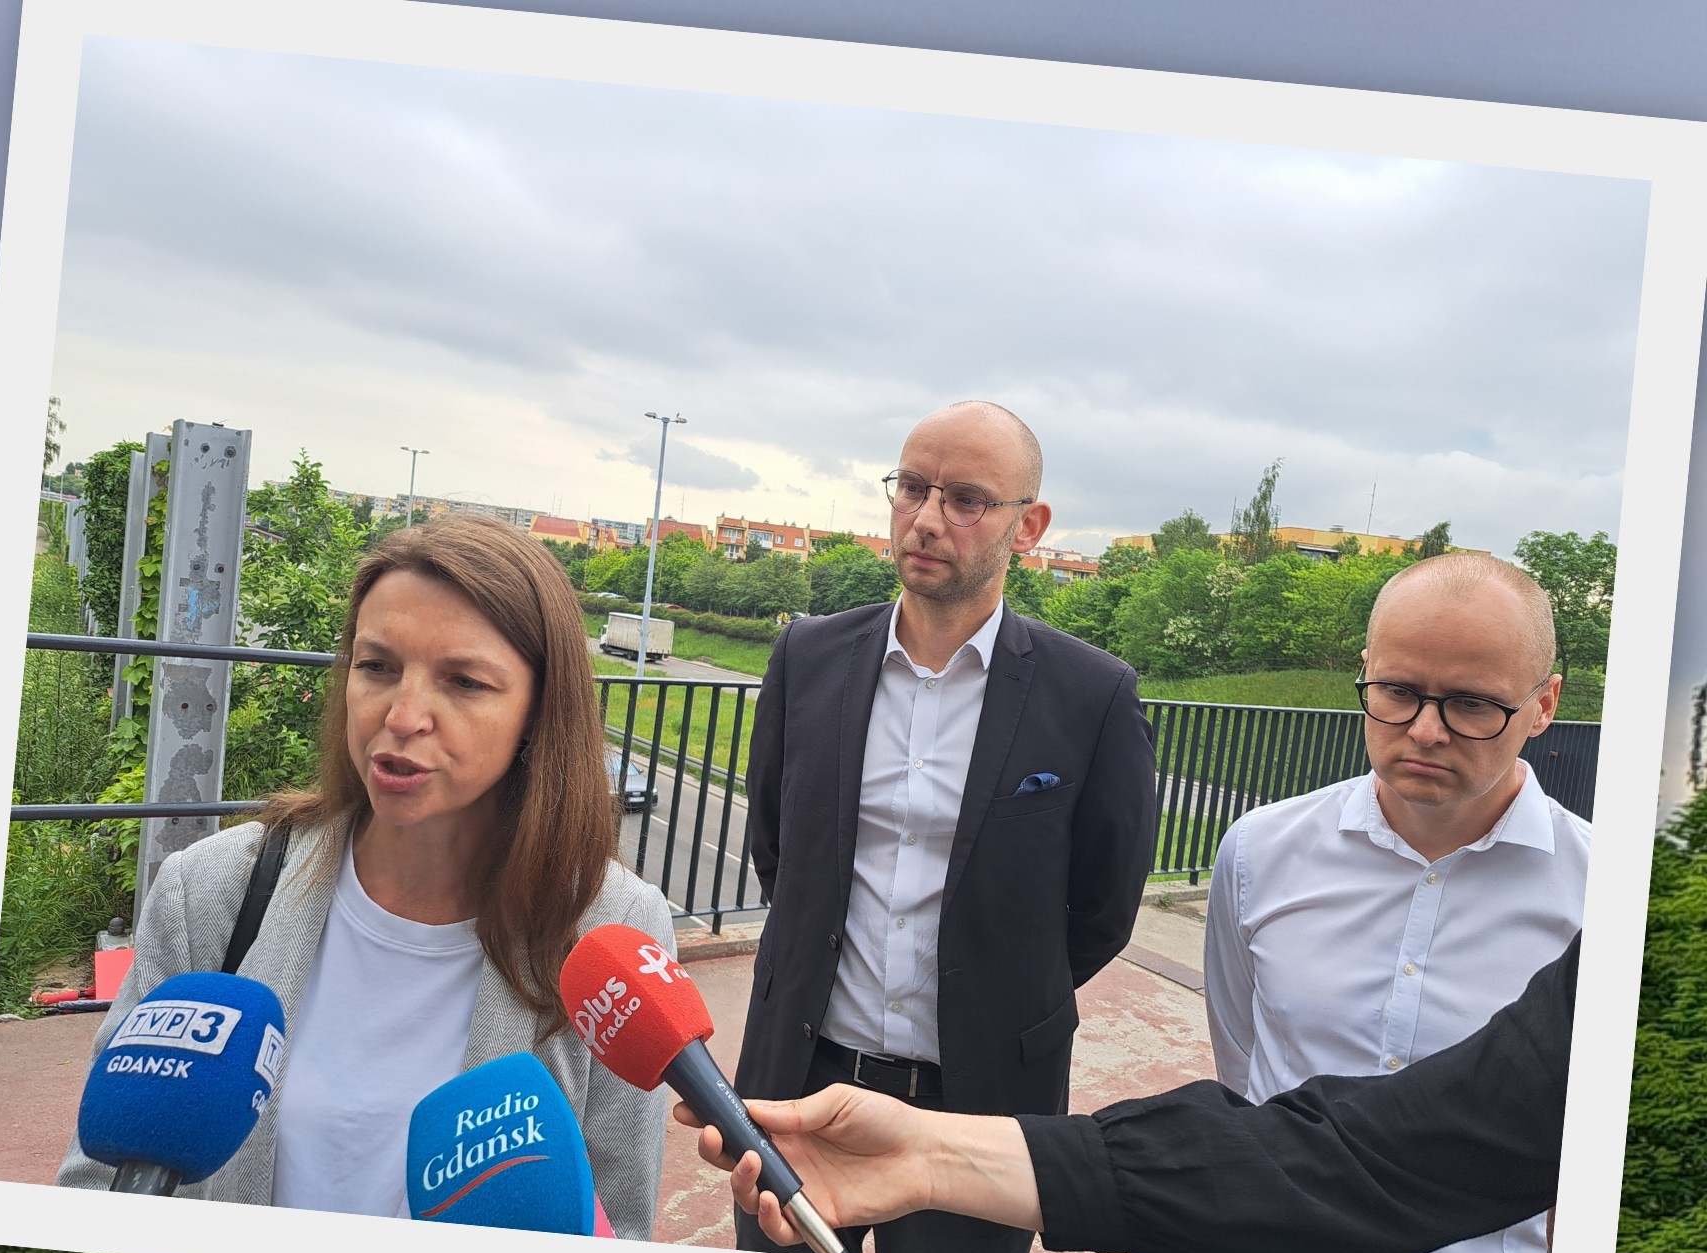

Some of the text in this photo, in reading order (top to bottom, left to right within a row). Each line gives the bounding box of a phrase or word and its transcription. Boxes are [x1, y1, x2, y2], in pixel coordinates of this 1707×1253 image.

[600, 997, 641, 1045] radio
[106, 1055, 194, 1079] GDANSK
[453, 1092, 539, 1138] Radio
[423, 1115, 547, 1191] Gdańsk
